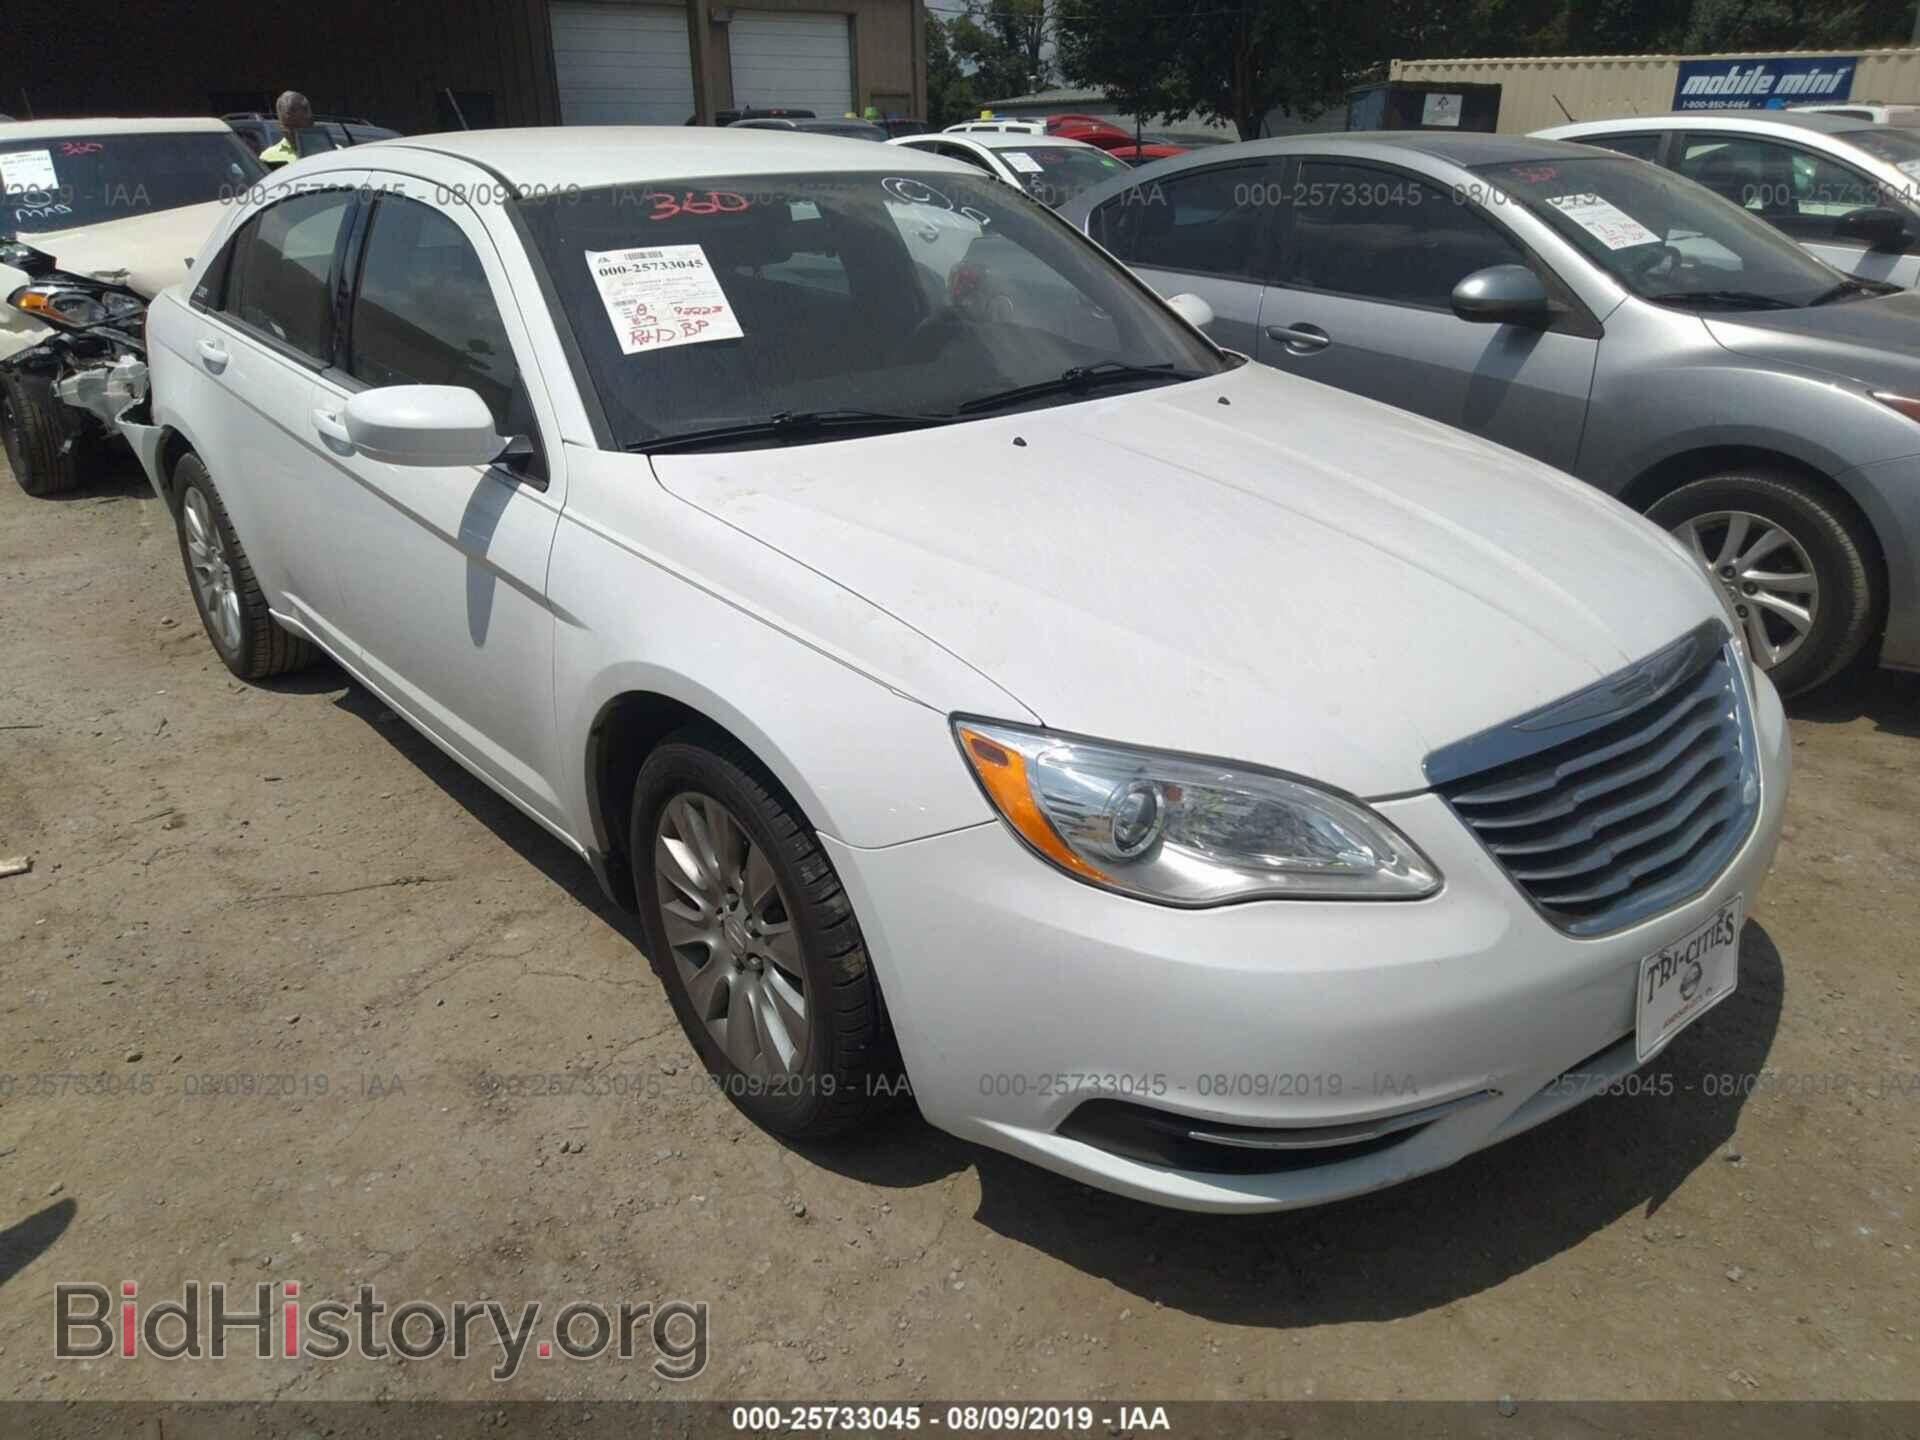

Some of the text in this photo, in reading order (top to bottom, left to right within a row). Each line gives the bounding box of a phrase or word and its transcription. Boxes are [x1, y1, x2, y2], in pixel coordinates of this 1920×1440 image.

[1681, 65, 1849, 95] mobile mini
[598, 258, 704, 277] 000-25733045
[1647, 912, 1734, 1004] TRI-CITIES
